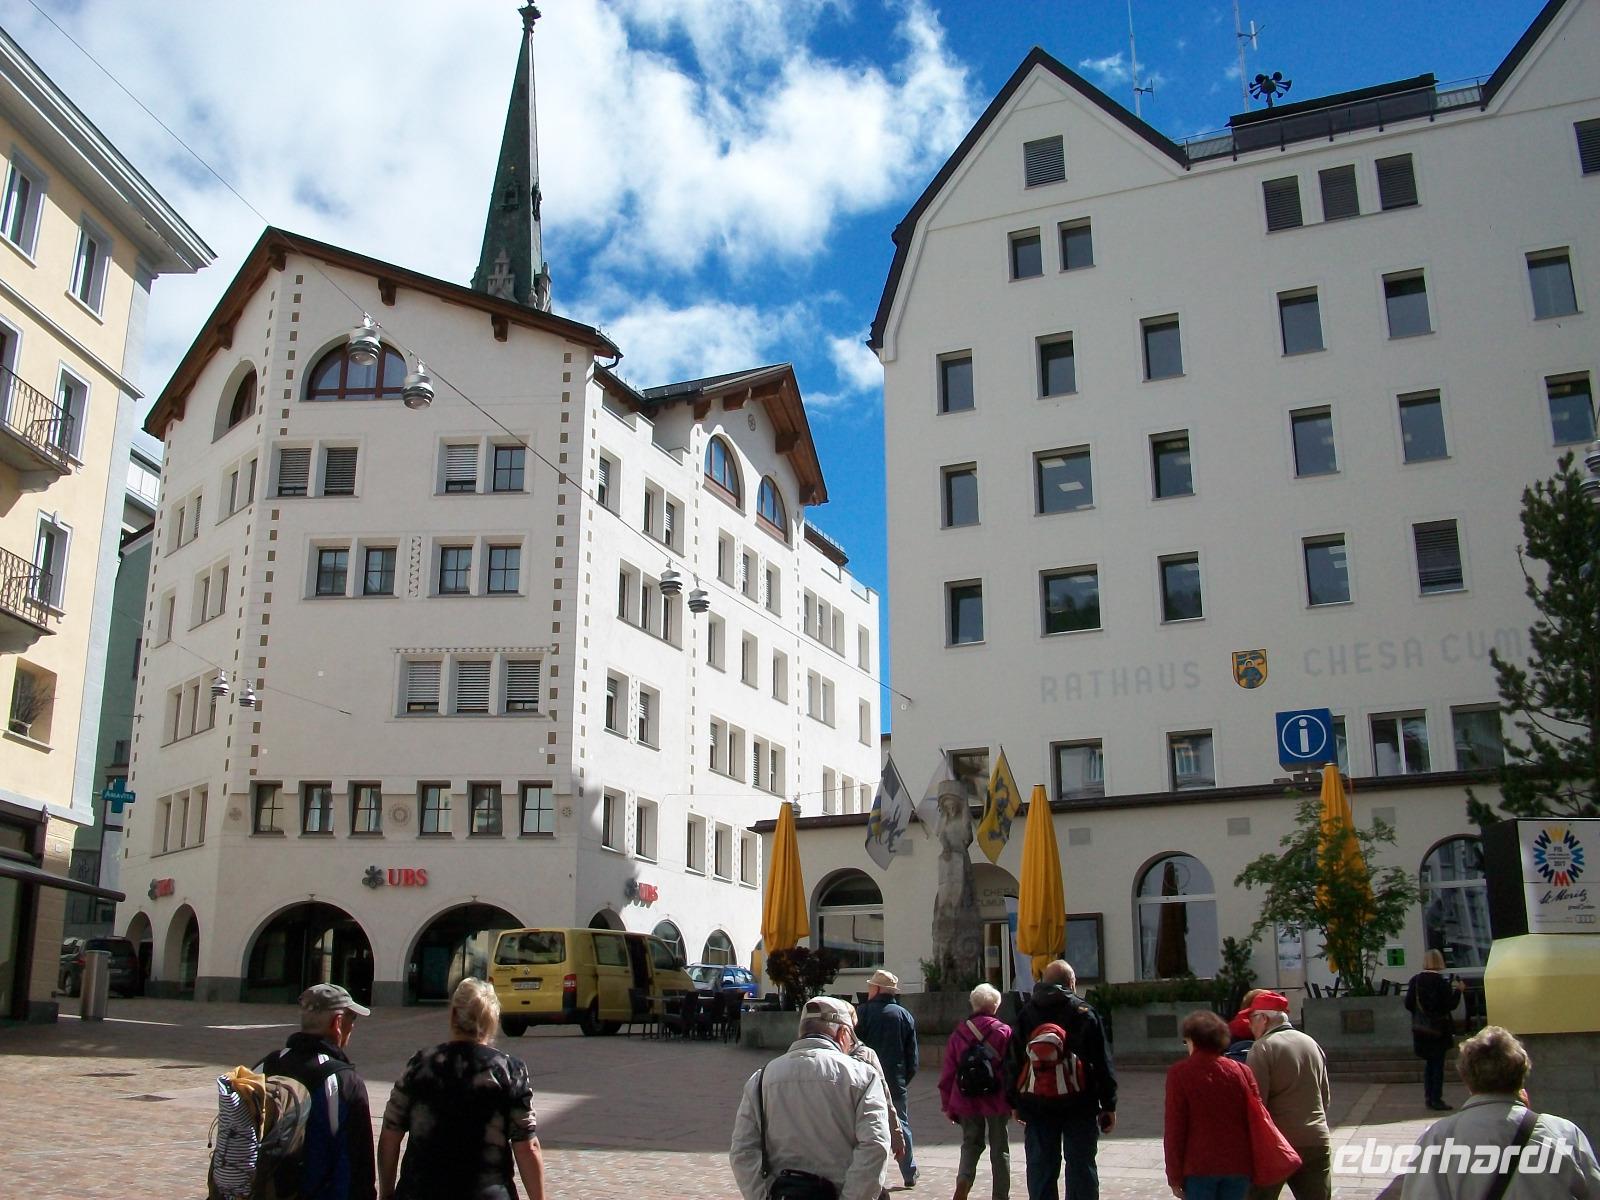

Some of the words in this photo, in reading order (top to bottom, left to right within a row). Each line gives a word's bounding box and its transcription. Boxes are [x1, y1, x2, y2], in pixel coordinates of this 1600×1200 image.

[1303, 637, 1424, 677] CHESA
[1040, 660, 1201, 703] RATHAUS
[387, 868, 428, 887] UBS
